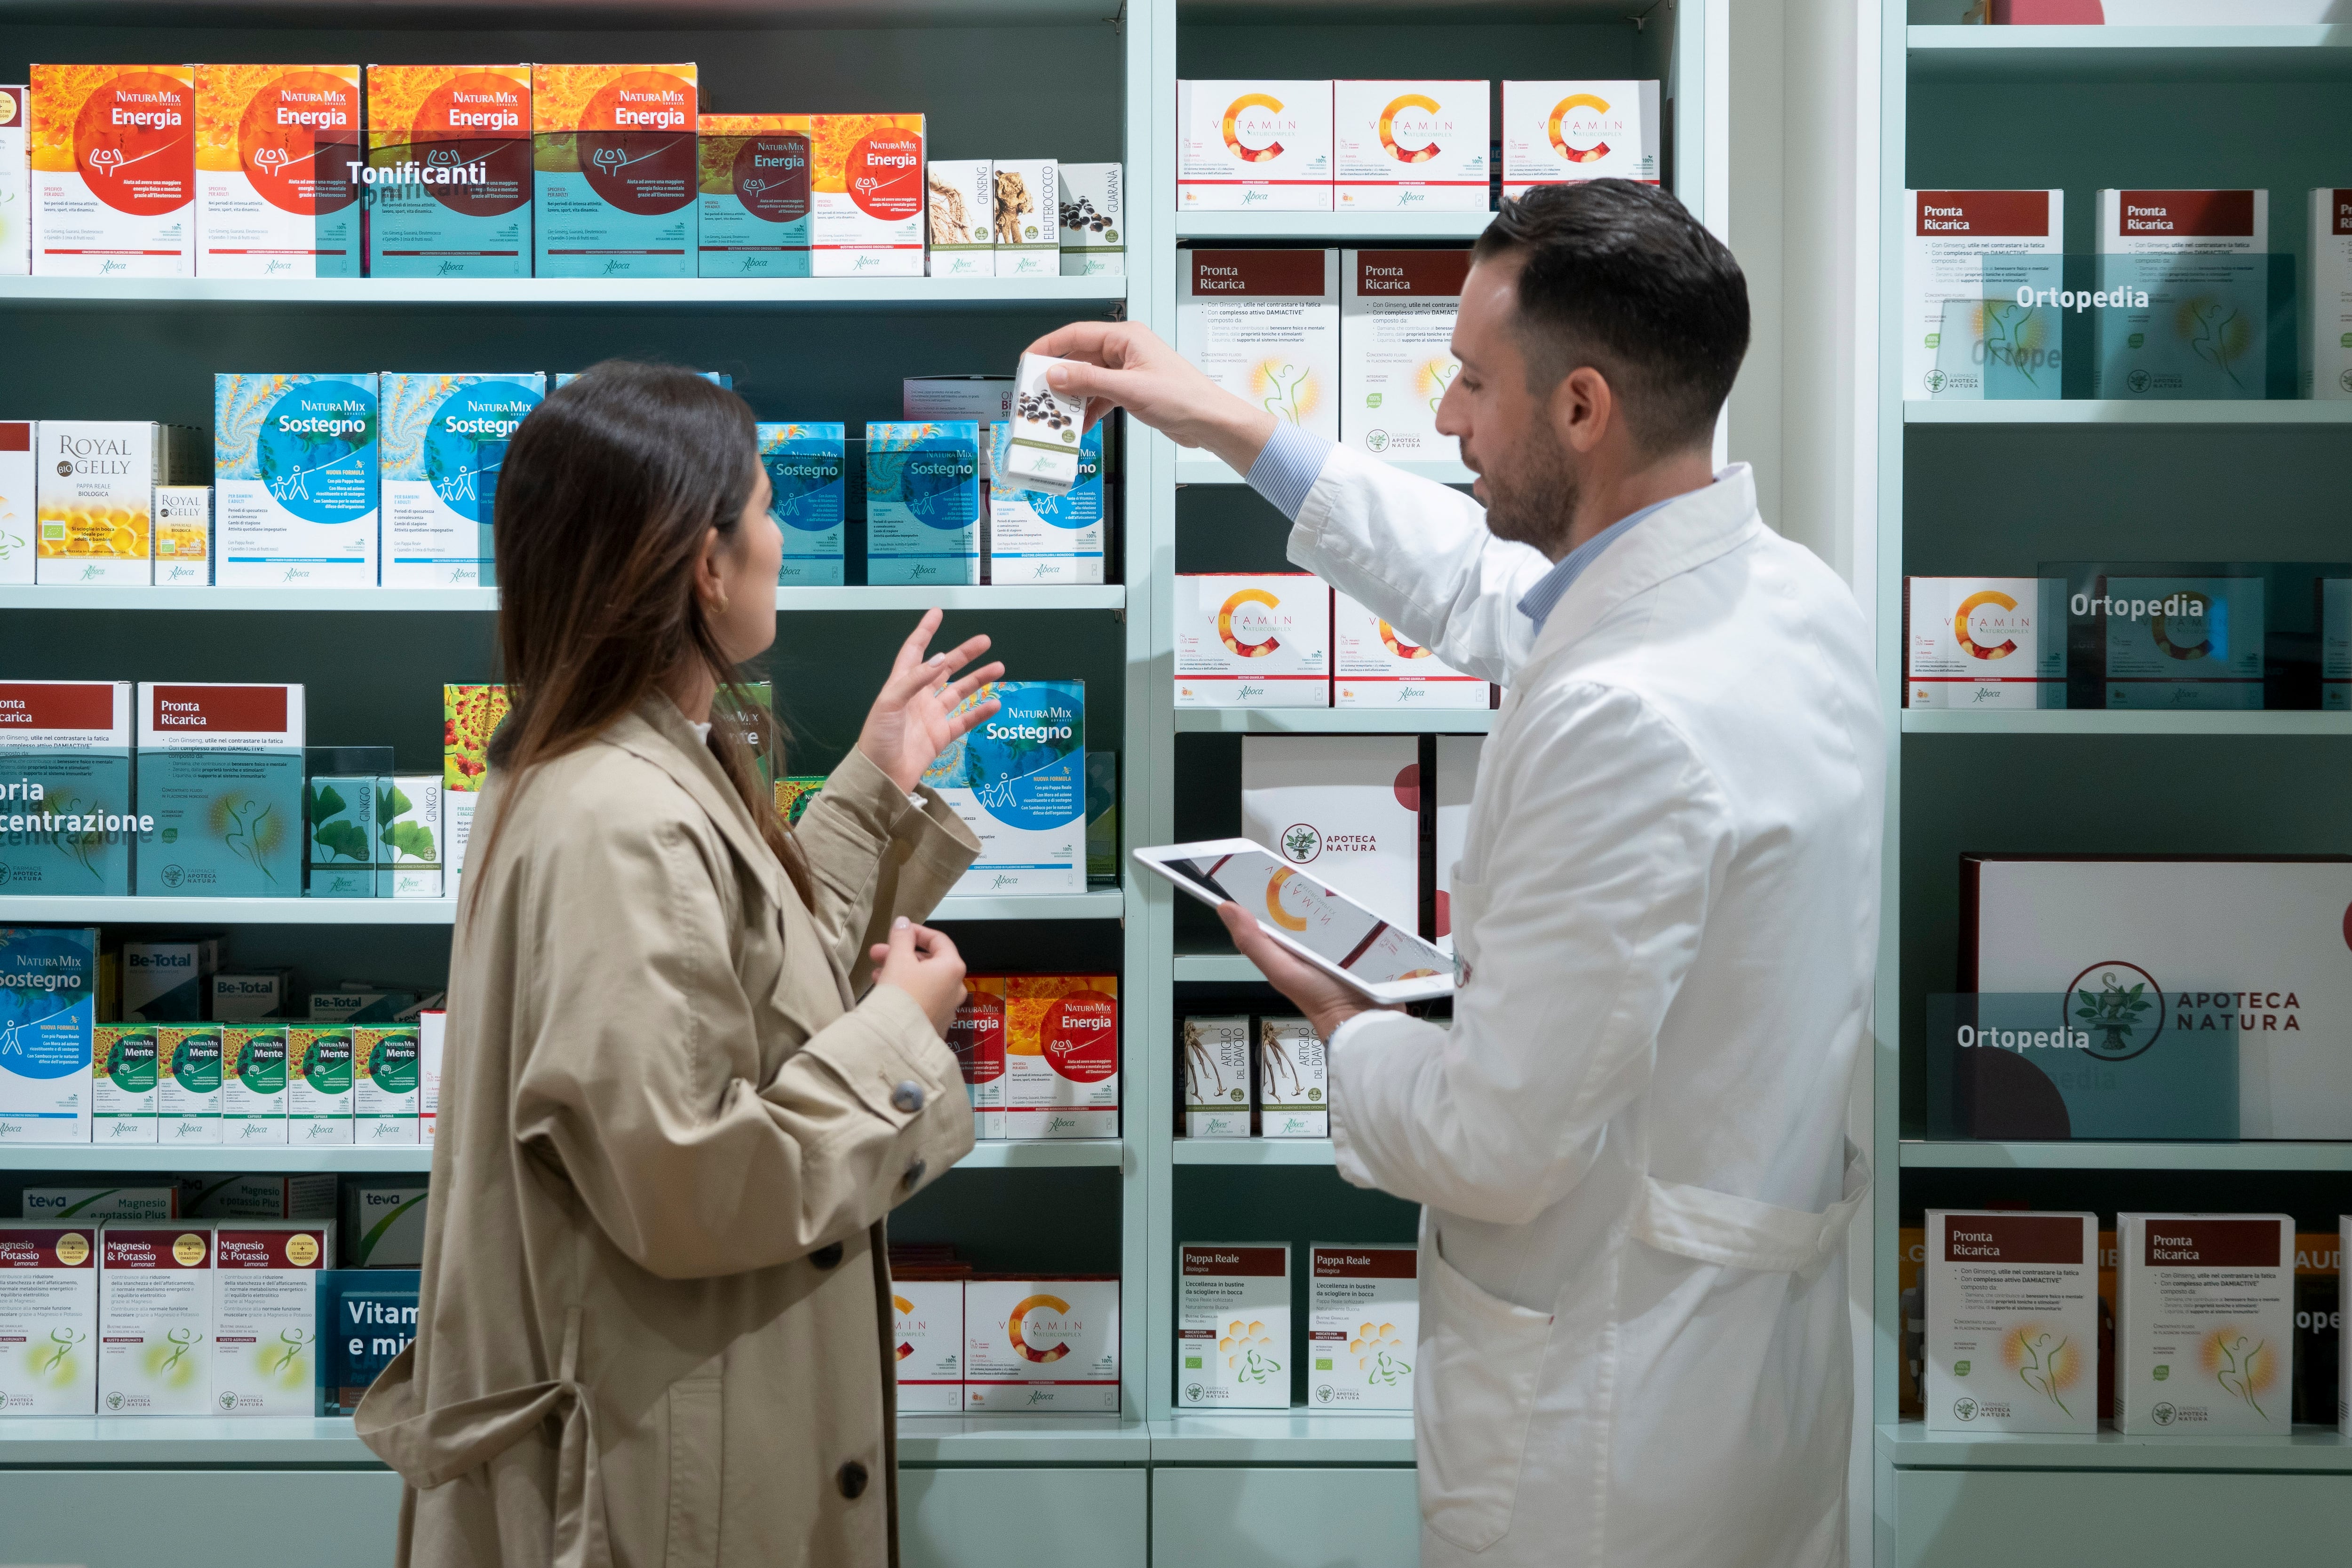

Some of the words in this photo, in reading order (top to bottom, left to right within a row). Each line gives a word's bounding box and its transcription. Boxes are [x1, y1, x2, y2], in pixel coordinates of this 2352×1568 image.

[112, 108, 181, 129] Energia
[278, 108, 346, 129] Energia
[450, 109, 518, 130] Energia
[616, 108, 684, 128] Energia
[1212, 120, 1295, 129] VITAMIN
[1369, 121, 1452, 129] VITAMIN
[1538, 121, 1622, 130] VITAMIN
[755, 154, 804, 169] Energia
[867, 153, 916, 168] Energia
[347, 162, 485, 184] Tonificanti
[977, 167, 988, 204] GINSENG
[1105, 170, 1118, 212] GUARANÀ
[1042, 166, 1054, 239] ELEUTEROCOCCO
[1241, 190, 1268, 205] Aboca
[1925, 206, 1963, 216] Pronta
[2128, 206, 2166, 216] Pronta
[1924, 219, 1970, 230] Ricarica
[2128, 219, 2173, 230] Ricarica
[100, 260, 126, 274] Aboca
[1201, 265, 1238, 275] Pronta
[1366, 266, 1403, 276] Pronta
[1201, 279, 1245, 289] Ricarica
[1366, 279, 1410, 289] Ricarica
[2017, 286, 2148, 312] Ortopedia
[279, 414, 365, 436] Sostegno
[445, 416, 519, 436] Sostegn
[60, 436, 131, 459] ROYAL
[58, 464, 72, 474] BIO
[75, 460, 130, 474] GELLY
[777, 464, 837, 478] Sostegno
[911, 463, 973, 477] Sostegno
[162, 495, 201, 507] ROYAL
[2072, 594, 2202, 621] Ortopedia
[1208, 616, 1291, 624] VITAMIN
[162, 701, 199, 711] Pronta
[162, 714, 207, 724] Ricarica
[986, 723, 1072, 743] Sostegno
[360, 787, 370, 822] GINKGO
[426, 787, 437, 822] GINKGO
[130, 954, 190, 967] Be-Total
[218, 982, 272, 993] Be-Total
[314, 996, 361, 1007] Be-Total
[2177, 993, 2299, 1009] APOTECA
[1063, 1015, 1111, 1030] Energia
[2177, 1015, 2300, 1031] NATURA
[1958, 1026, 2089, 1053] Ortopedia
[1220, 1028, 1232, 1066] ARTIGLIO
[1234, 1028, 1244, 1066] DIAVOLO
[28, 1195, 66, 1207] teva
[119, 1199, 166, 1210] Magnesio
[366, 1194, 399, 1205] teva
[1954, 1231, 1993, 1241] Pronta
[2154, 1235, 2192, 1245] Pronta
[108, 1242, 151, 1253] Magnesio
[222, 1241, 264, 1253] Magnesio
[1954, 1244, 2000, 1255] Ricarica
[108, 1251, 115, 1260] &
[118, 1251, 156, 1260] Potassio
[1186, 1254, 1213, 1264] Pappa
[2154, 1249, 2199, 1259] Ricarica
[1318, 1256, 1344, 1266] Pappa
[349, 1338, 363, 1355] e
[373, 1333, 412, 1355] mi
